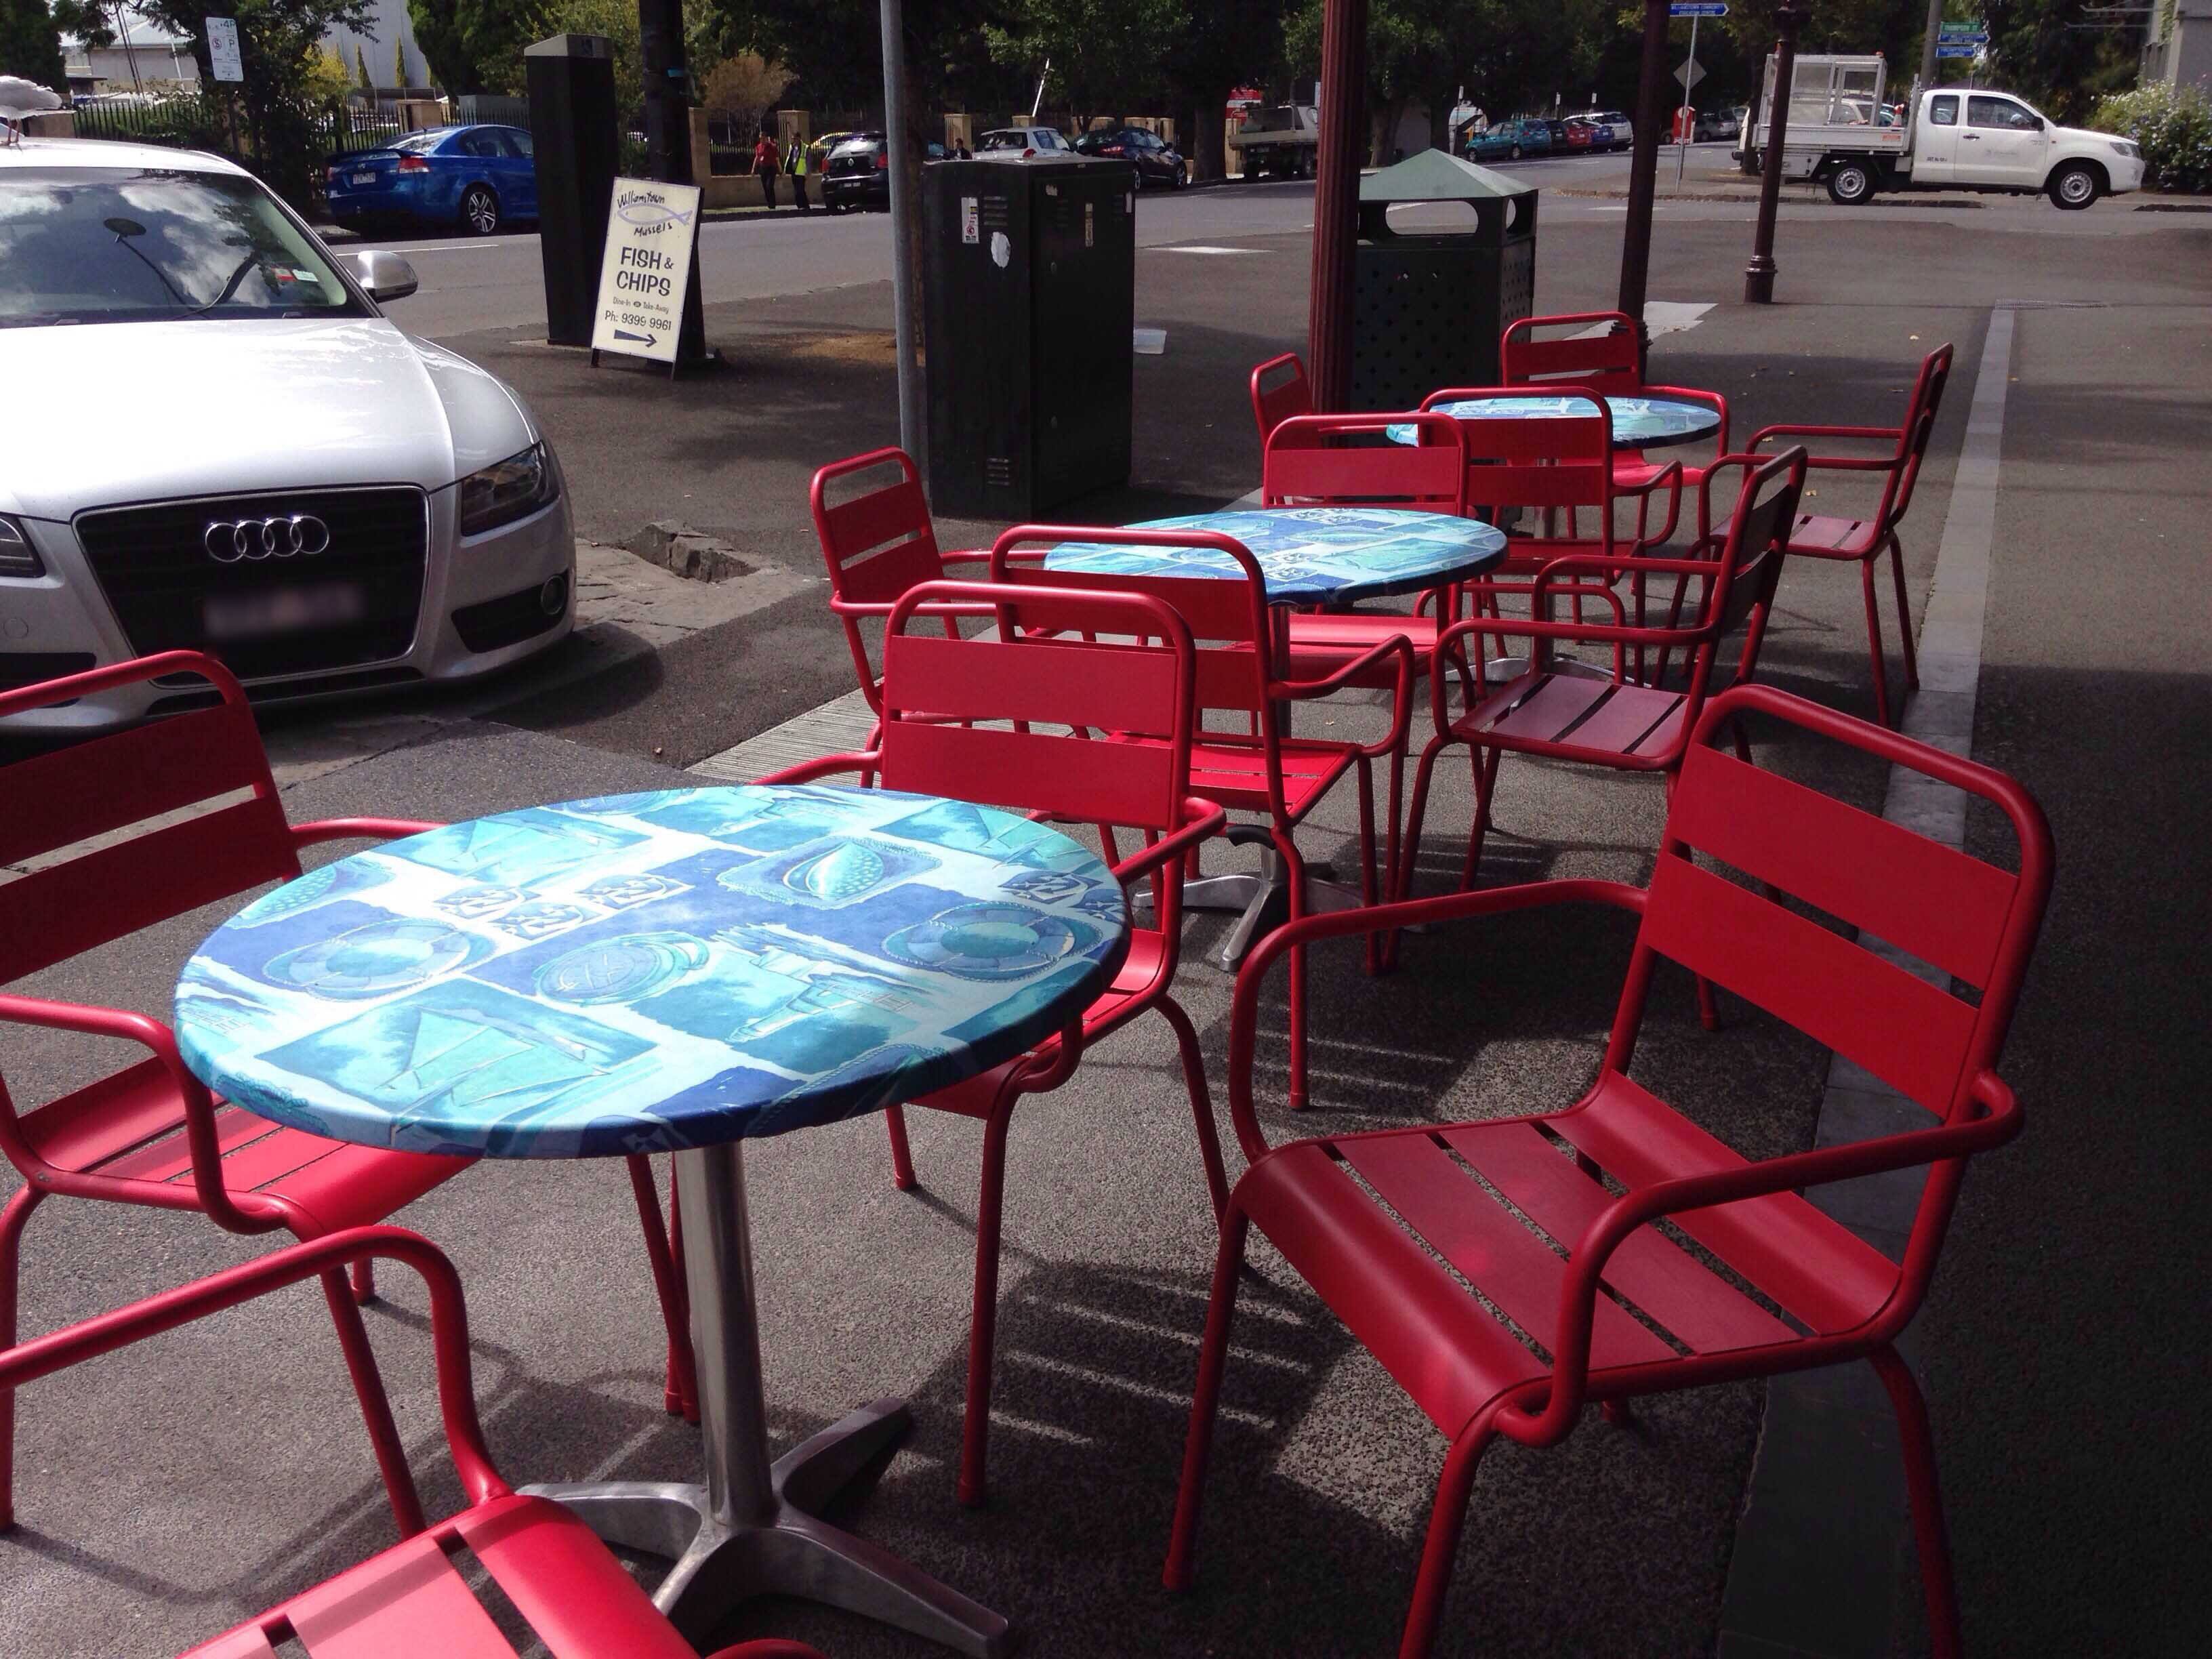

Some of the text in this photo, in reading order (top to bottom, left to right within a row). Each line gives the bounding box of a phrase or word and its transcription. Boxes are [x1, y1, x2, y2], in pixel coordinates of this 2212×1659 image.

[617, 190, 665, 208] Williamstown
[634, 222, 672, 237] Mussels
[620, 247, 674, 270] FISH &
[617, 270, 671, 297] CHIPS
[605, 310, 671, 331] Ph: 9399 9961
